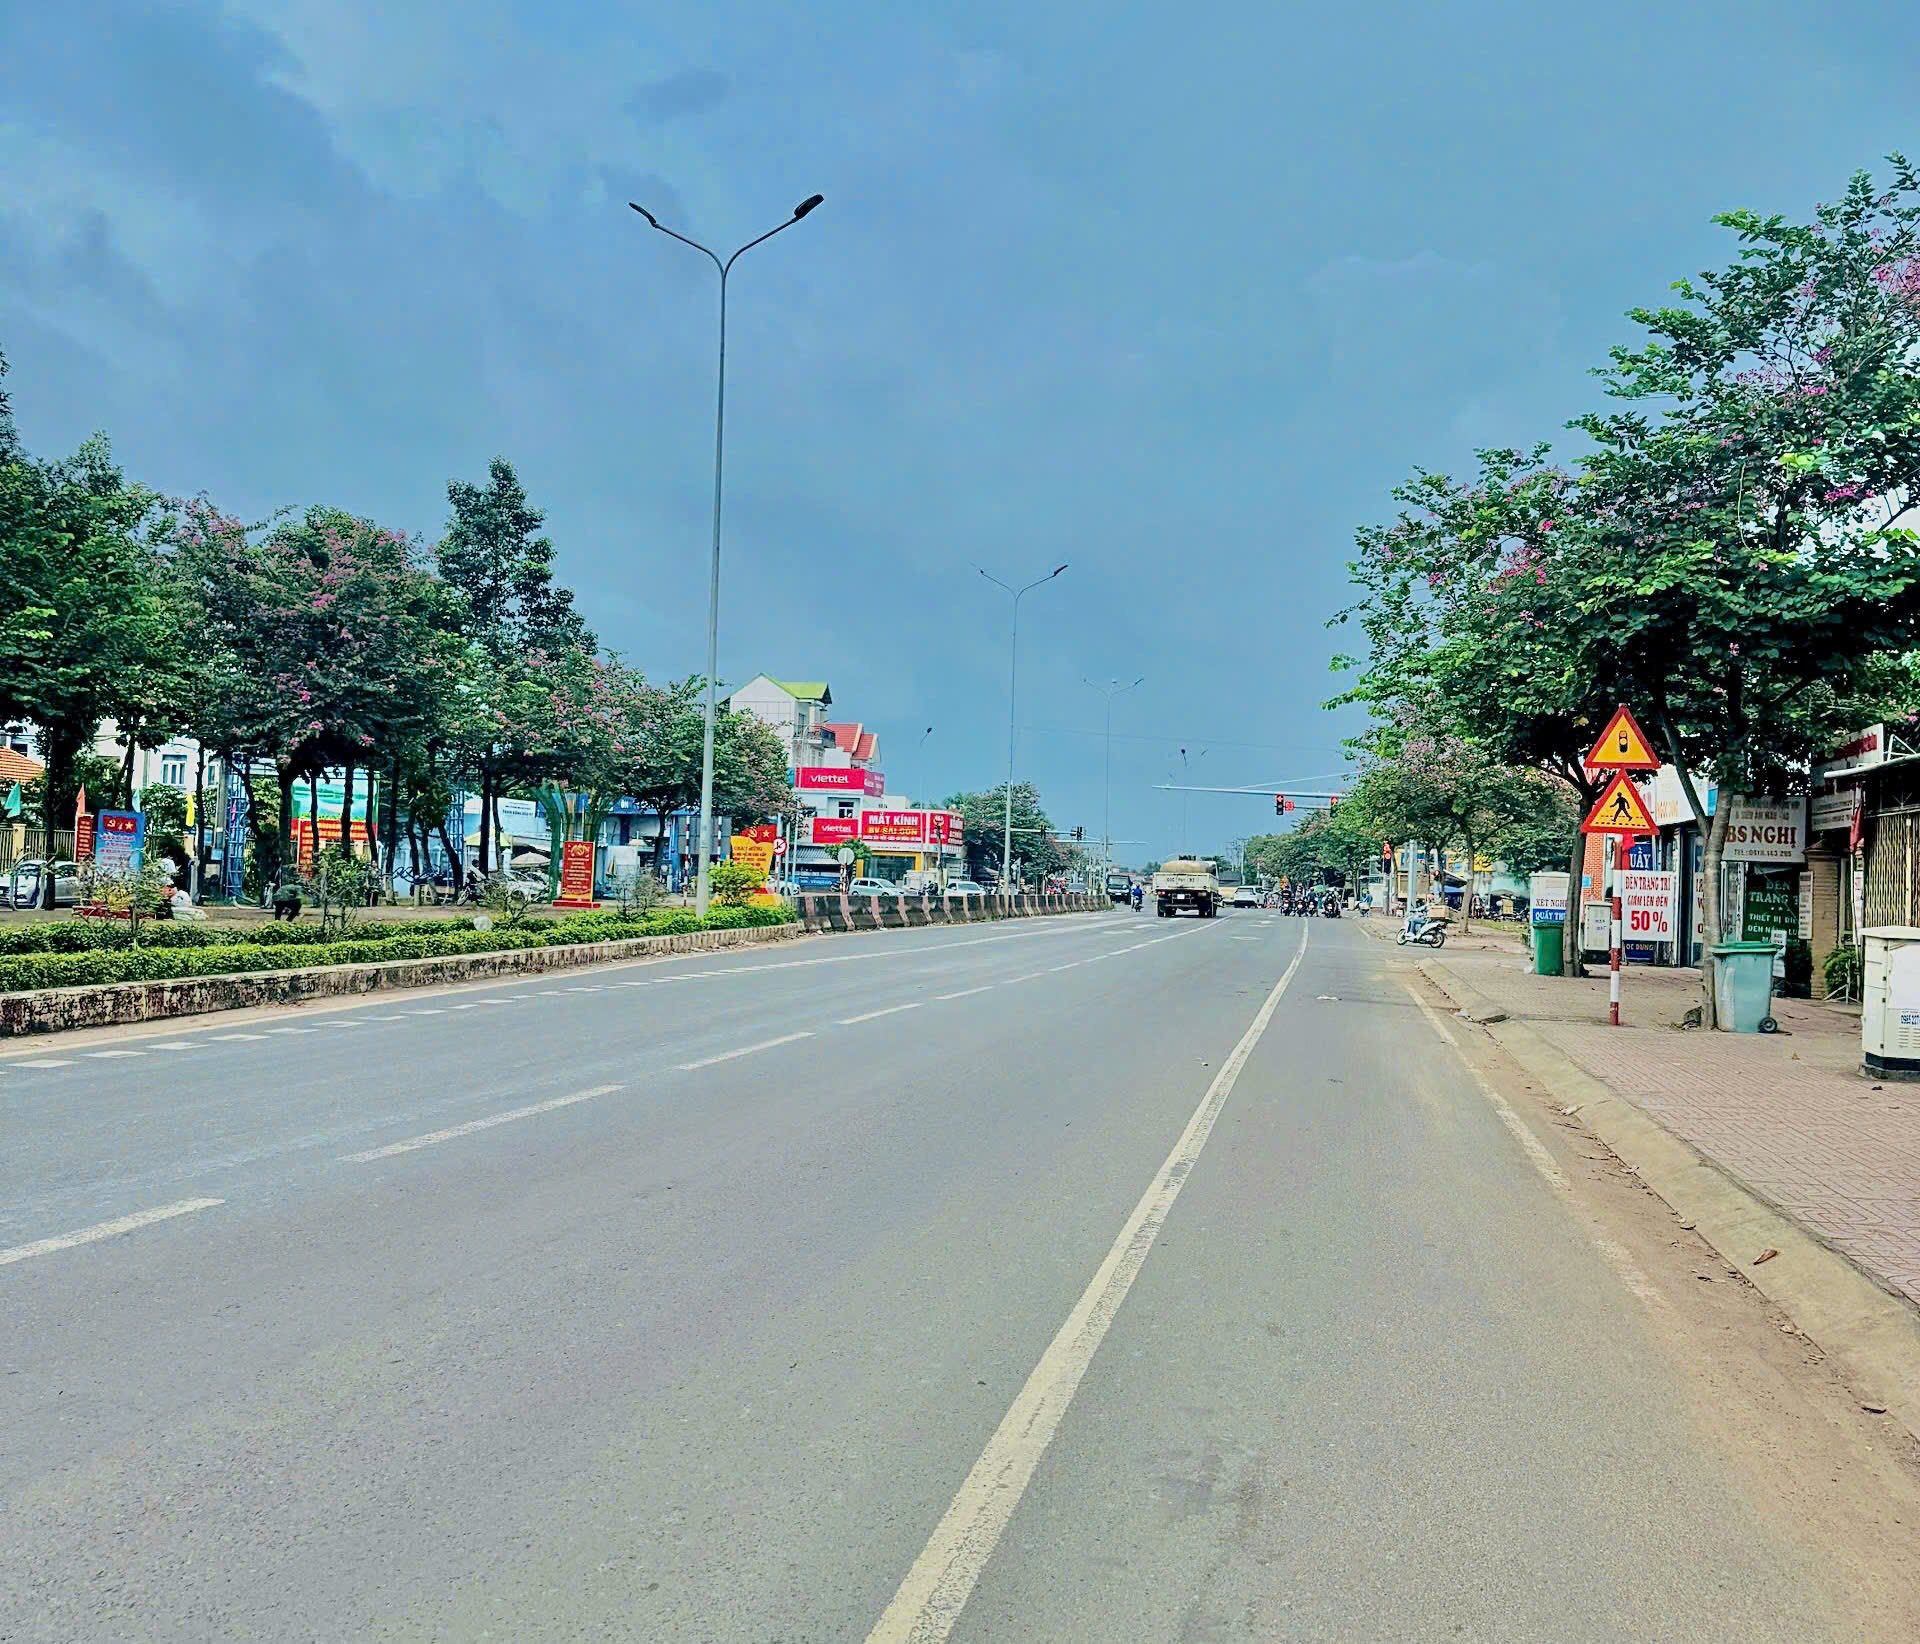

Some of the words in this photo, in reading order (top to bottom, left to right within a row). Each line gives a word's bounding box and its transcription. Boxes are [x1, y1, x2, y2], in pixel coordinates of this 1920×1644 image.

[810, 775, 849, 783] viettel
[893, 814, 919, 826] KÍNH
[821, 825, 852, 833] viettel
[1727, 825, 1748, 843] BS
[1751, 826, 1797, 848] NGHỊ
[1629, 847, 1652, 869] UẦY
